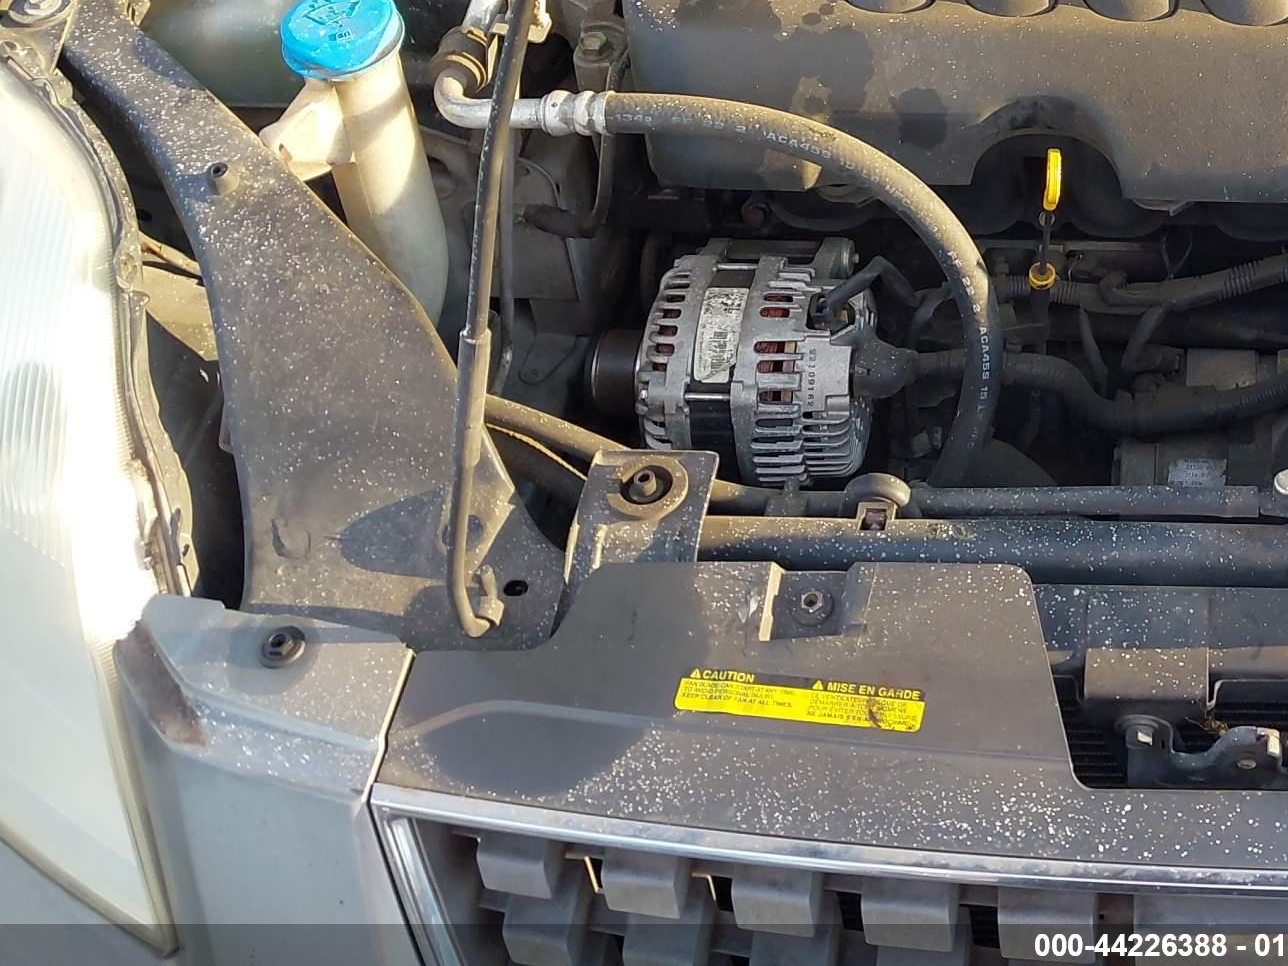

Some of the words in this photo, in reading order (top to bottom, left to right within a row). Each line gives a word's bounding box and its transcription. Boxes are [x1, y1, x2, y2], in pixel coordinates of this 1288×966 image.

[702, 669, 755, 683] CAUTION
[827, 682, 857, 693] MISE
[859, 685, 875, 695] EN
[878, 687, 921, 700] GARDE
